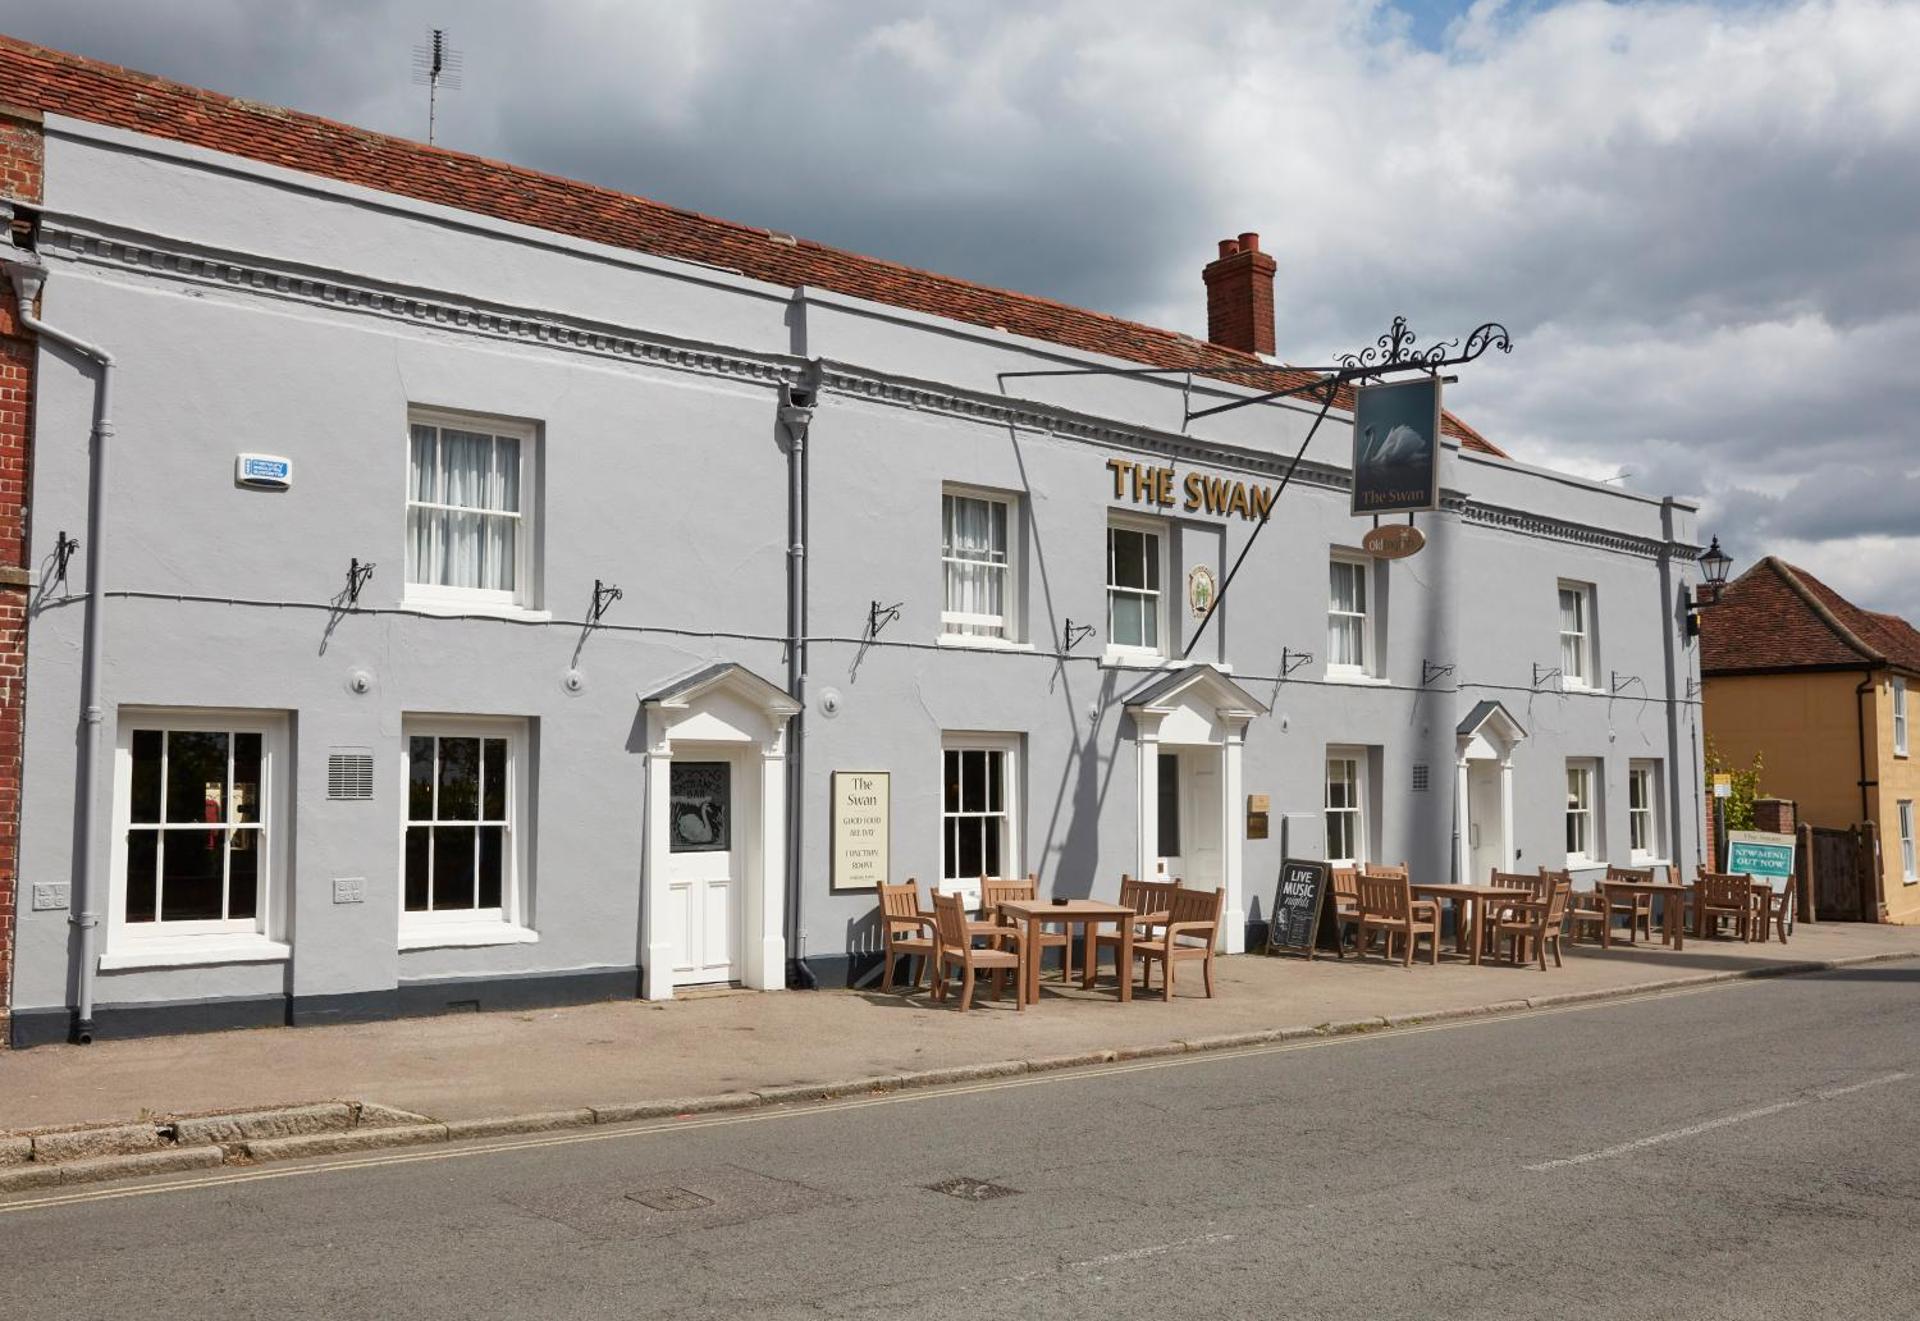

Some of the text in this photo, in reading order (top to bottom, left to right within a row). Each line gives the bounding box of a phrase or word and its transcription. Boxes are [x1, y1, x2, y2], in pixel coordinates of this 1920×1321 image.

[1107, 458, 1272, 519] THE SWAN
[1362, 489, 1424, 504] The Swan
[852, 778, 873, 790] The
[848, 794, 877, 806] Swan
[843, 817, 881, 825] GOOD FOOD
[845, 849, 879, 857] FUNCTION
[1735, 848, 1787, 859] NEW MENU
[852, 861, 872, 870] ROOM
[1737, 858, 1784, 868] OUT NOW
[1291, 869, 1313, 883] LIVE
[1283, 882, 1316, 897] MUSIC
